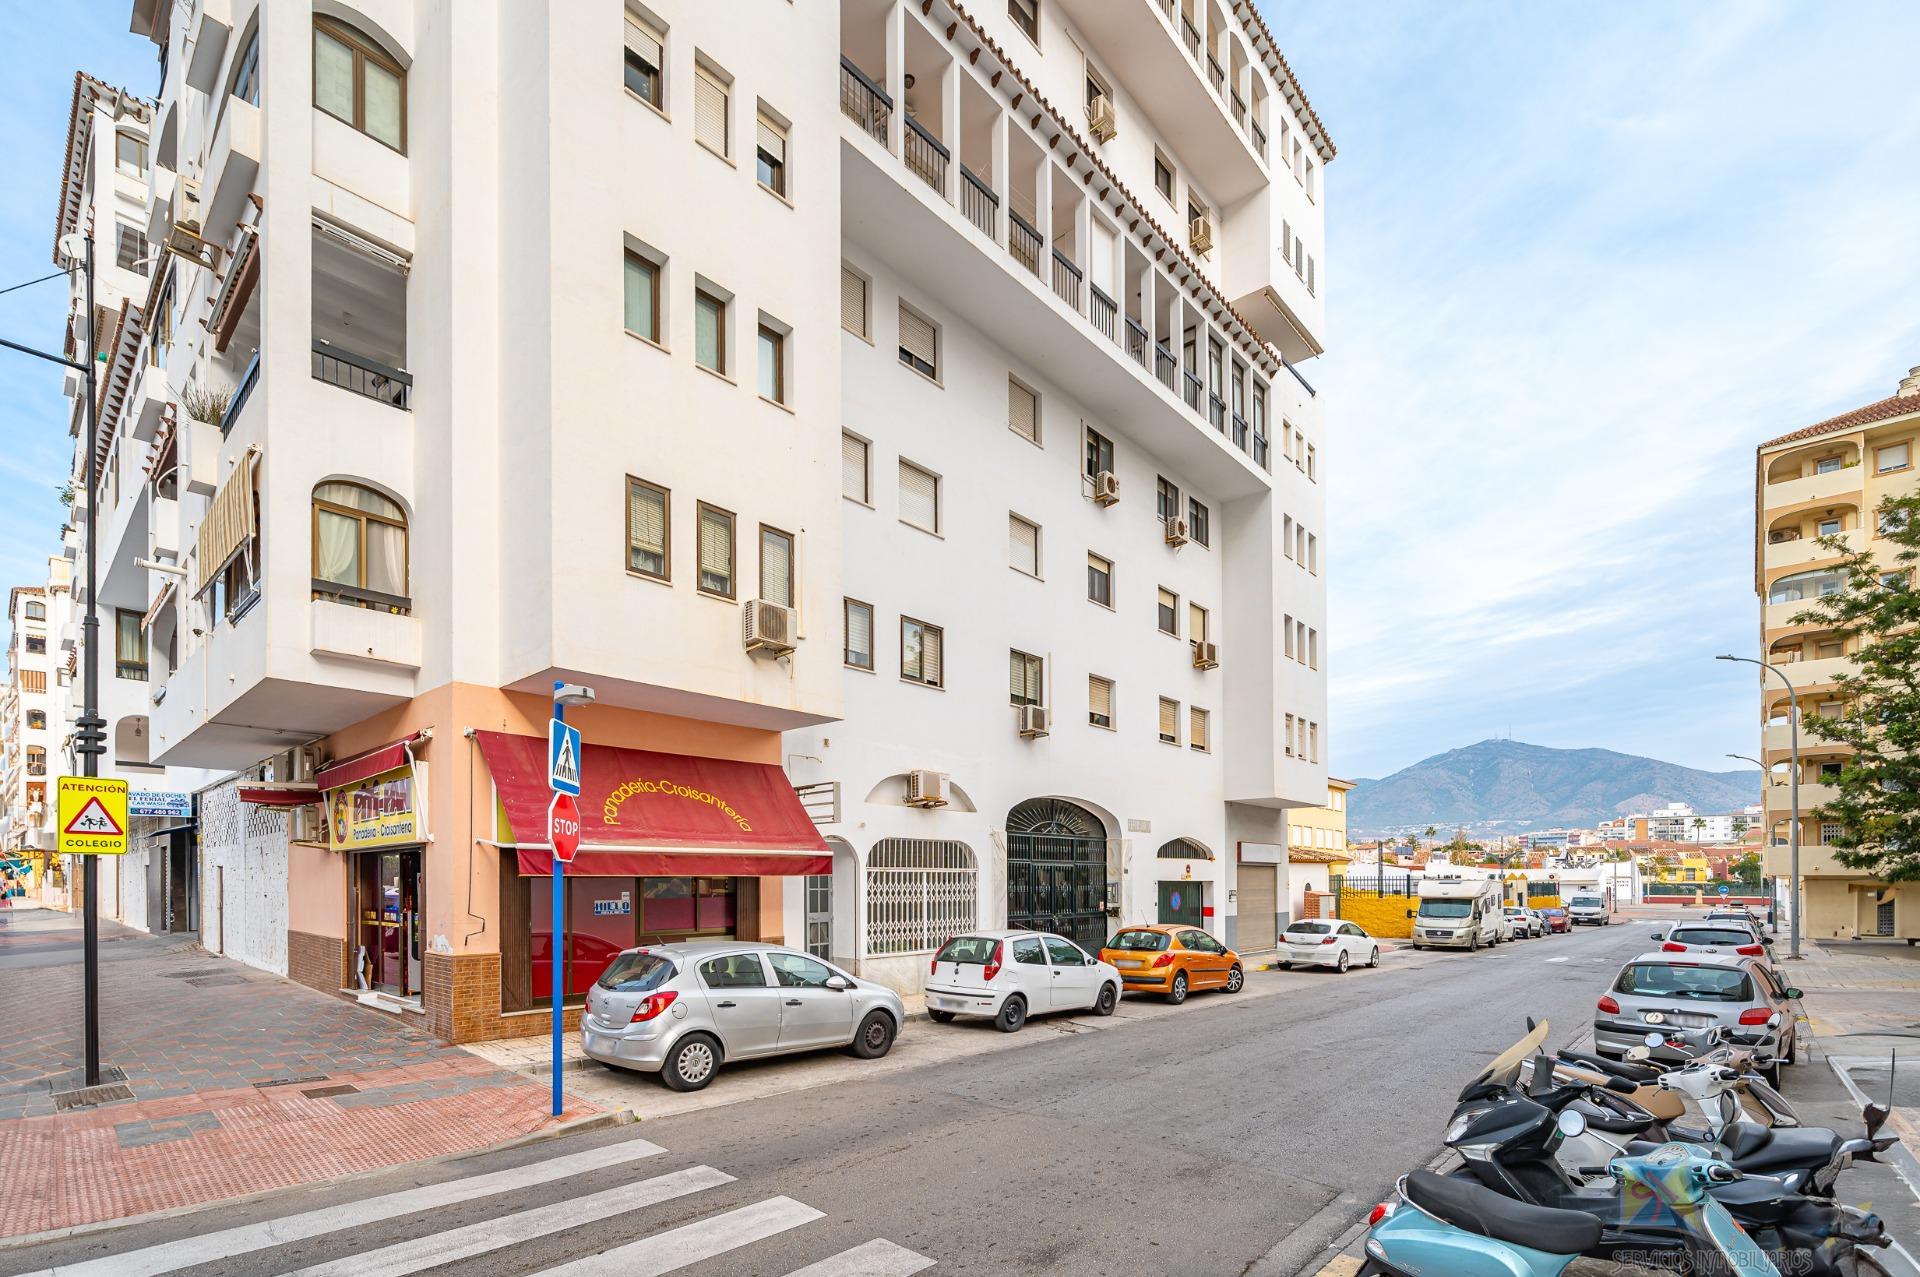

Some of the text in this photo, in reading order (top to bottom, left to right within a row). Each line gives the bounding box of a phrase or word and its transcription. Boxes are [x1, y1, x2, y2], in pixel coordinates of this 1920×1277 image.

[62, 783, 126, 793] ATENCIÓN
[554, 818, 578, 836] STOP
[66, 840, 122, 848] COLEGIO
